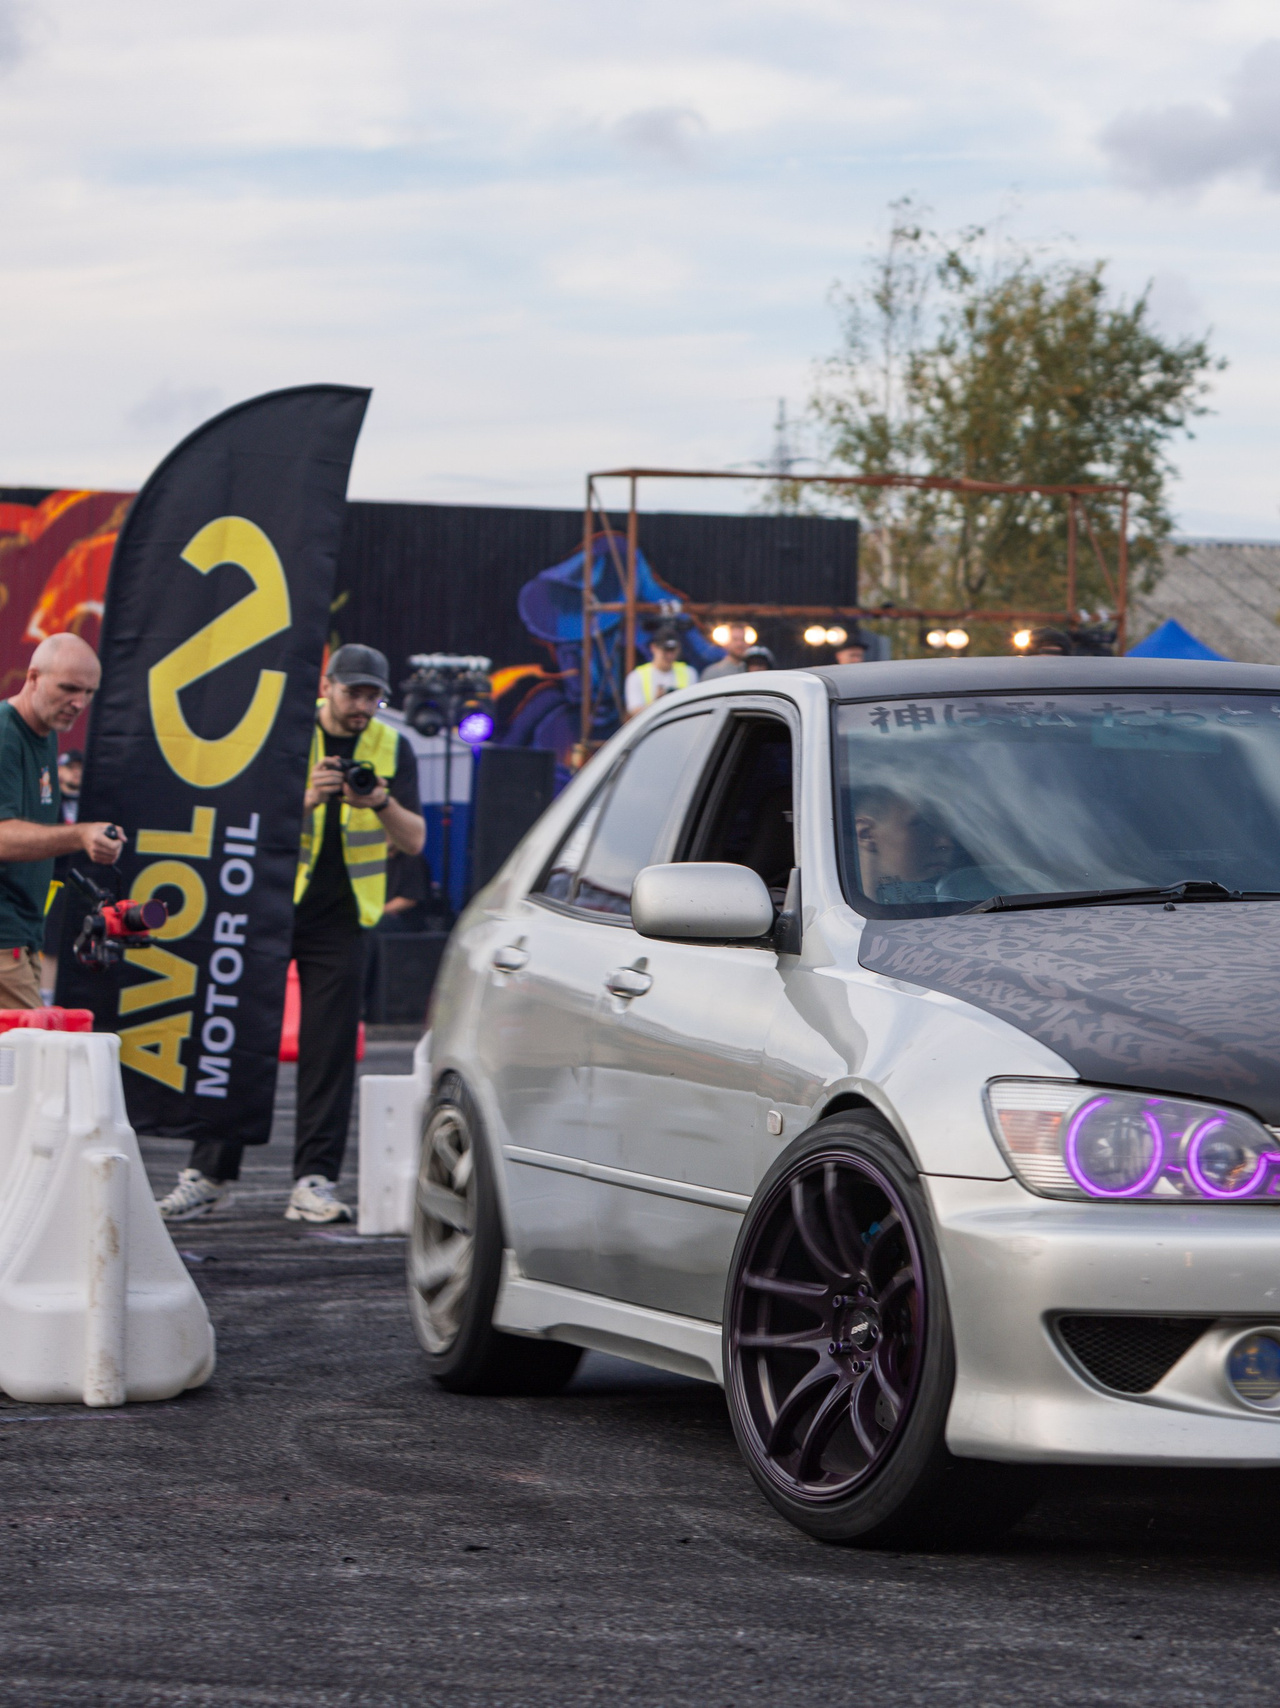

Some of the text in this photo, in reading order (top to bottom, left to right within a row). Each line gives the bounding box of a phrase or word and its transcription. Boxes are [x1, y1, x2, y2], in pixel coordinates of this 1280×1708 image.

[118, 806, 217, 1093] AVOL
[194, 812, 260, 1099] MOTOR OIL
